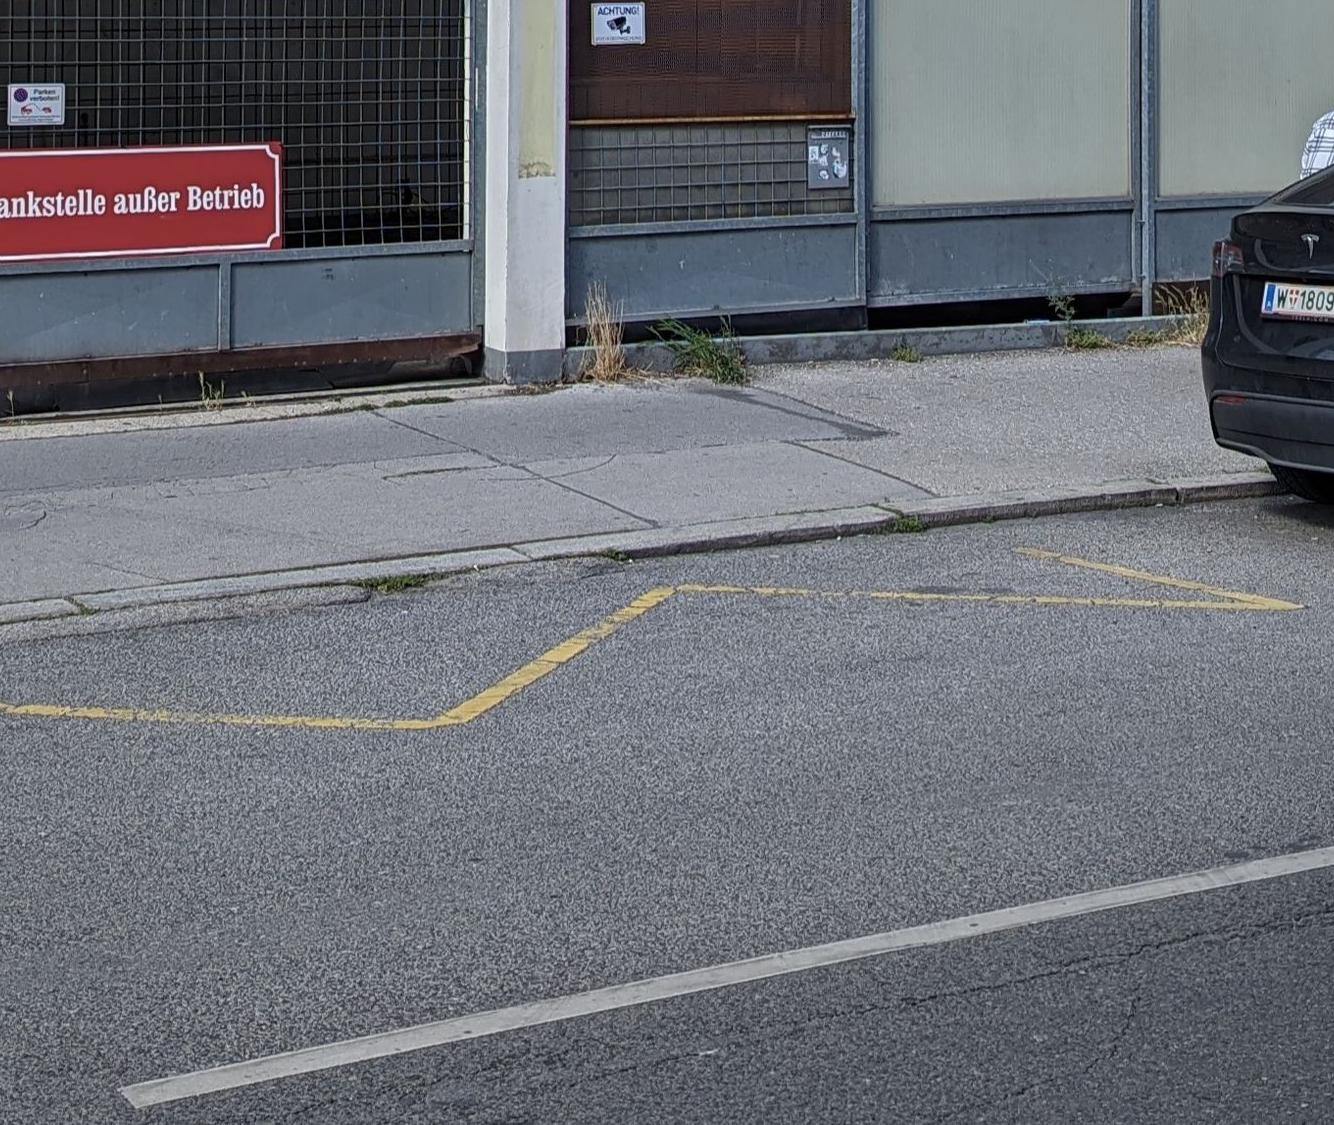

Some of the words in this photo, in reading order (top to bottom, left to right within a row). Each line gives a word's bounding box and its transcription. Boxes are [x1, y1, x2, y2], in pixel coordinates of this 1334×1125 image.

[597, 6, 640, 15] ACHTUNG!
[113, 186, 181, 215] außer
[186, 182, 265, 211] Betrieb
